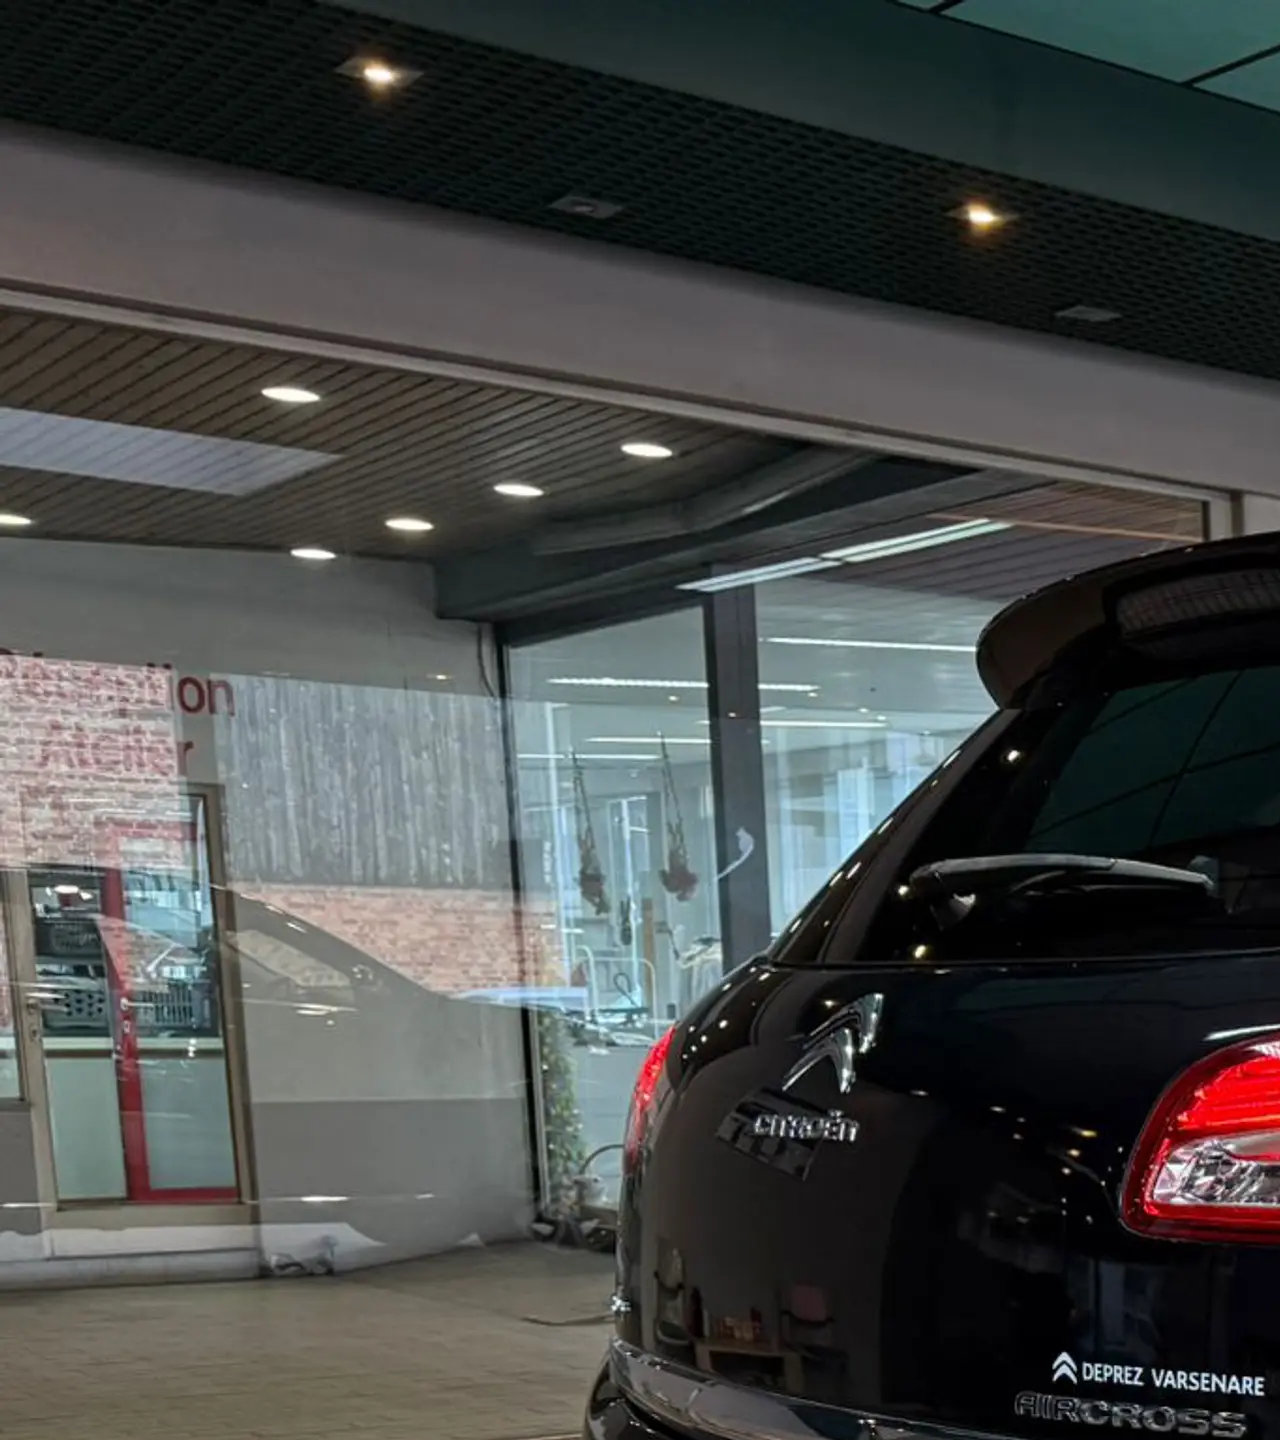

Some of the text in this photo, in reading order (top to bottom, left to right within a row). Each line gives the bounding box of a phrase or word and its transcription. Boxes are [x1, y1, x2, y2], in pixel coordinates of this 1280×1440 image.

[1081, 1361, 1266, 1397] DEPREZ VARSENARE
[1014, 1390, 1248, 1439] AIRCROSS
